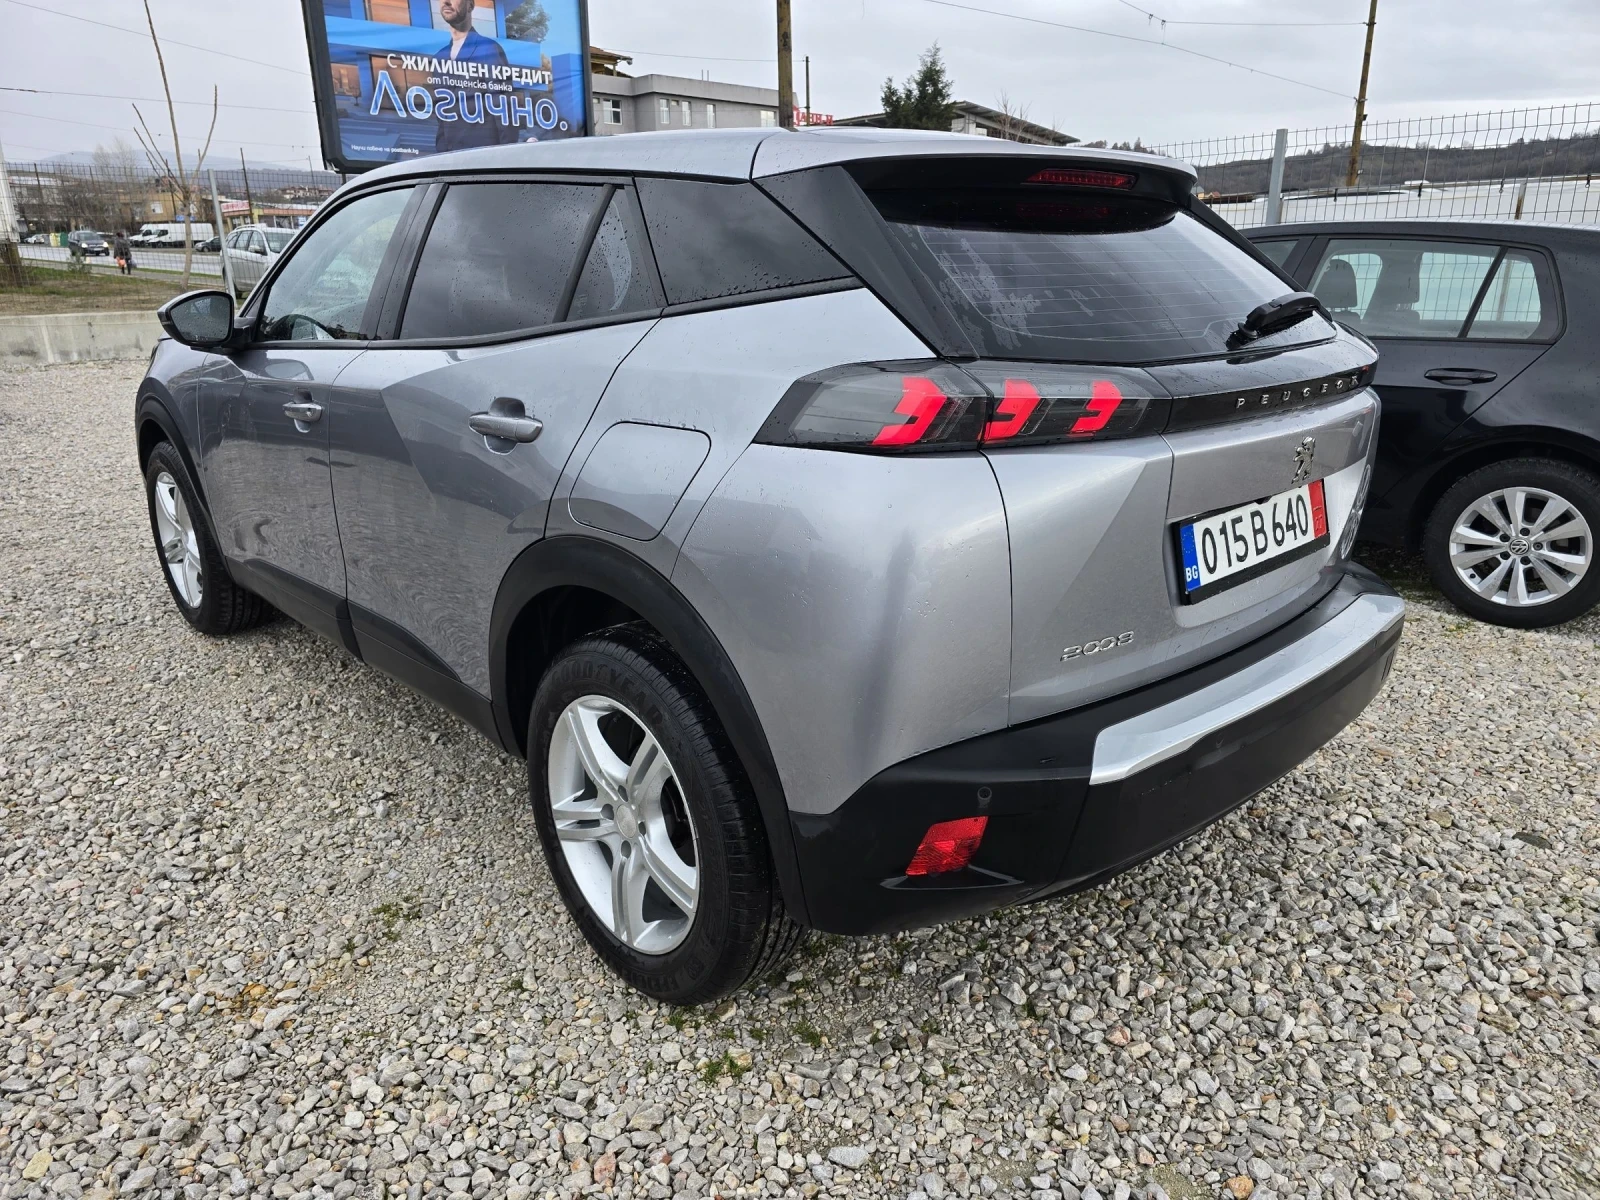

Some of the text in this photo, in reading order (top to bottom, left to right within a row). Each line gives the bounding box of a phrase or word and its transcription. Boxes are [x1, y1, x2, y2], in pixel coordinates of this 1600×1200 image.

[386, 53, 552, 86] С ЖИЛИЩЕН КРЕДИТ
[426, 75, 513, 92] от Пощенска банка
[370, 69, 568, 131] Логично.
[1201, 494, 1309, 575] 015B640
[1185, 565, 1199, 582] BG
[1060, 630, 1135, 662] 2008
